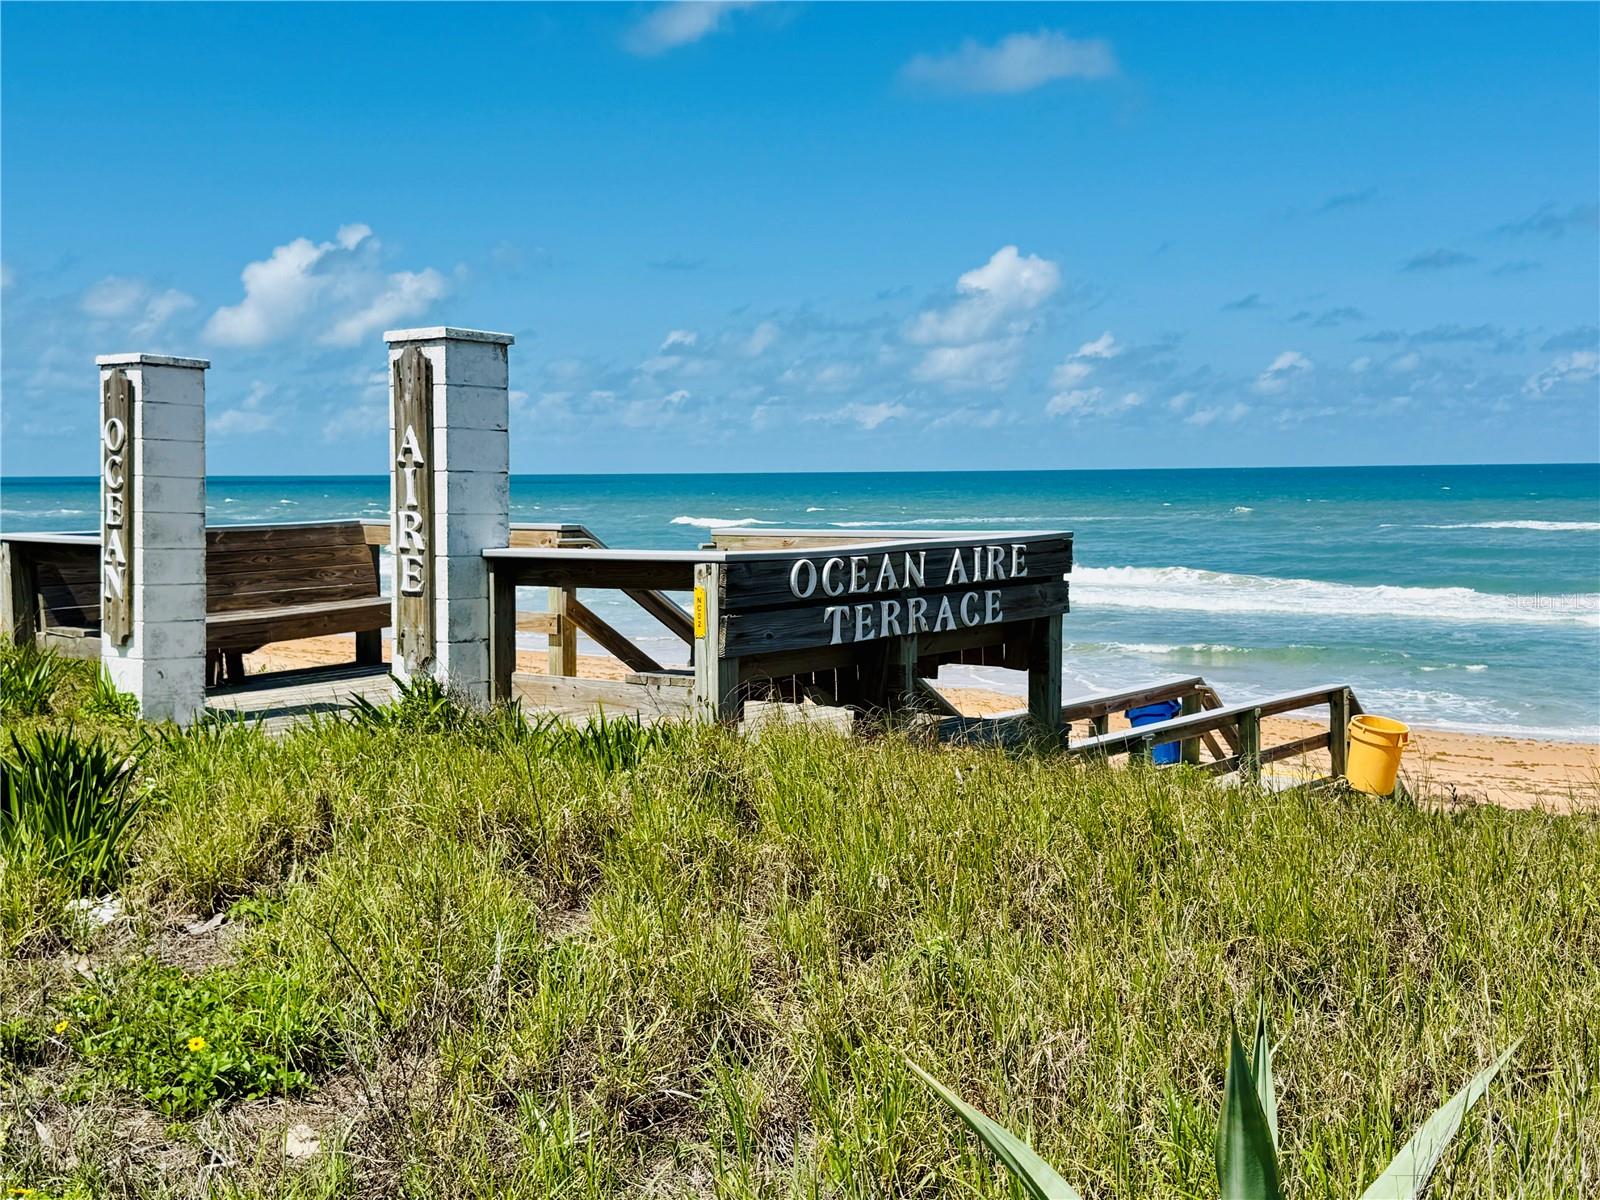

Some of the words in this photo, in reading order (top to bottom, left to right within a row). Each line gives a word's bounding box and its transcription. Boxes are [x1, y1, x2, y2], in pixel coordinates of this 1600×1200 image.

[103, 417, 126, 600] OCEAN
[396, 424, 424, 596] AIRE
[790, 549, 926, 599] OCEAN
[945, 544, 1028, 584] AIRE
[823, 589, 1004, 645] TERRACE
